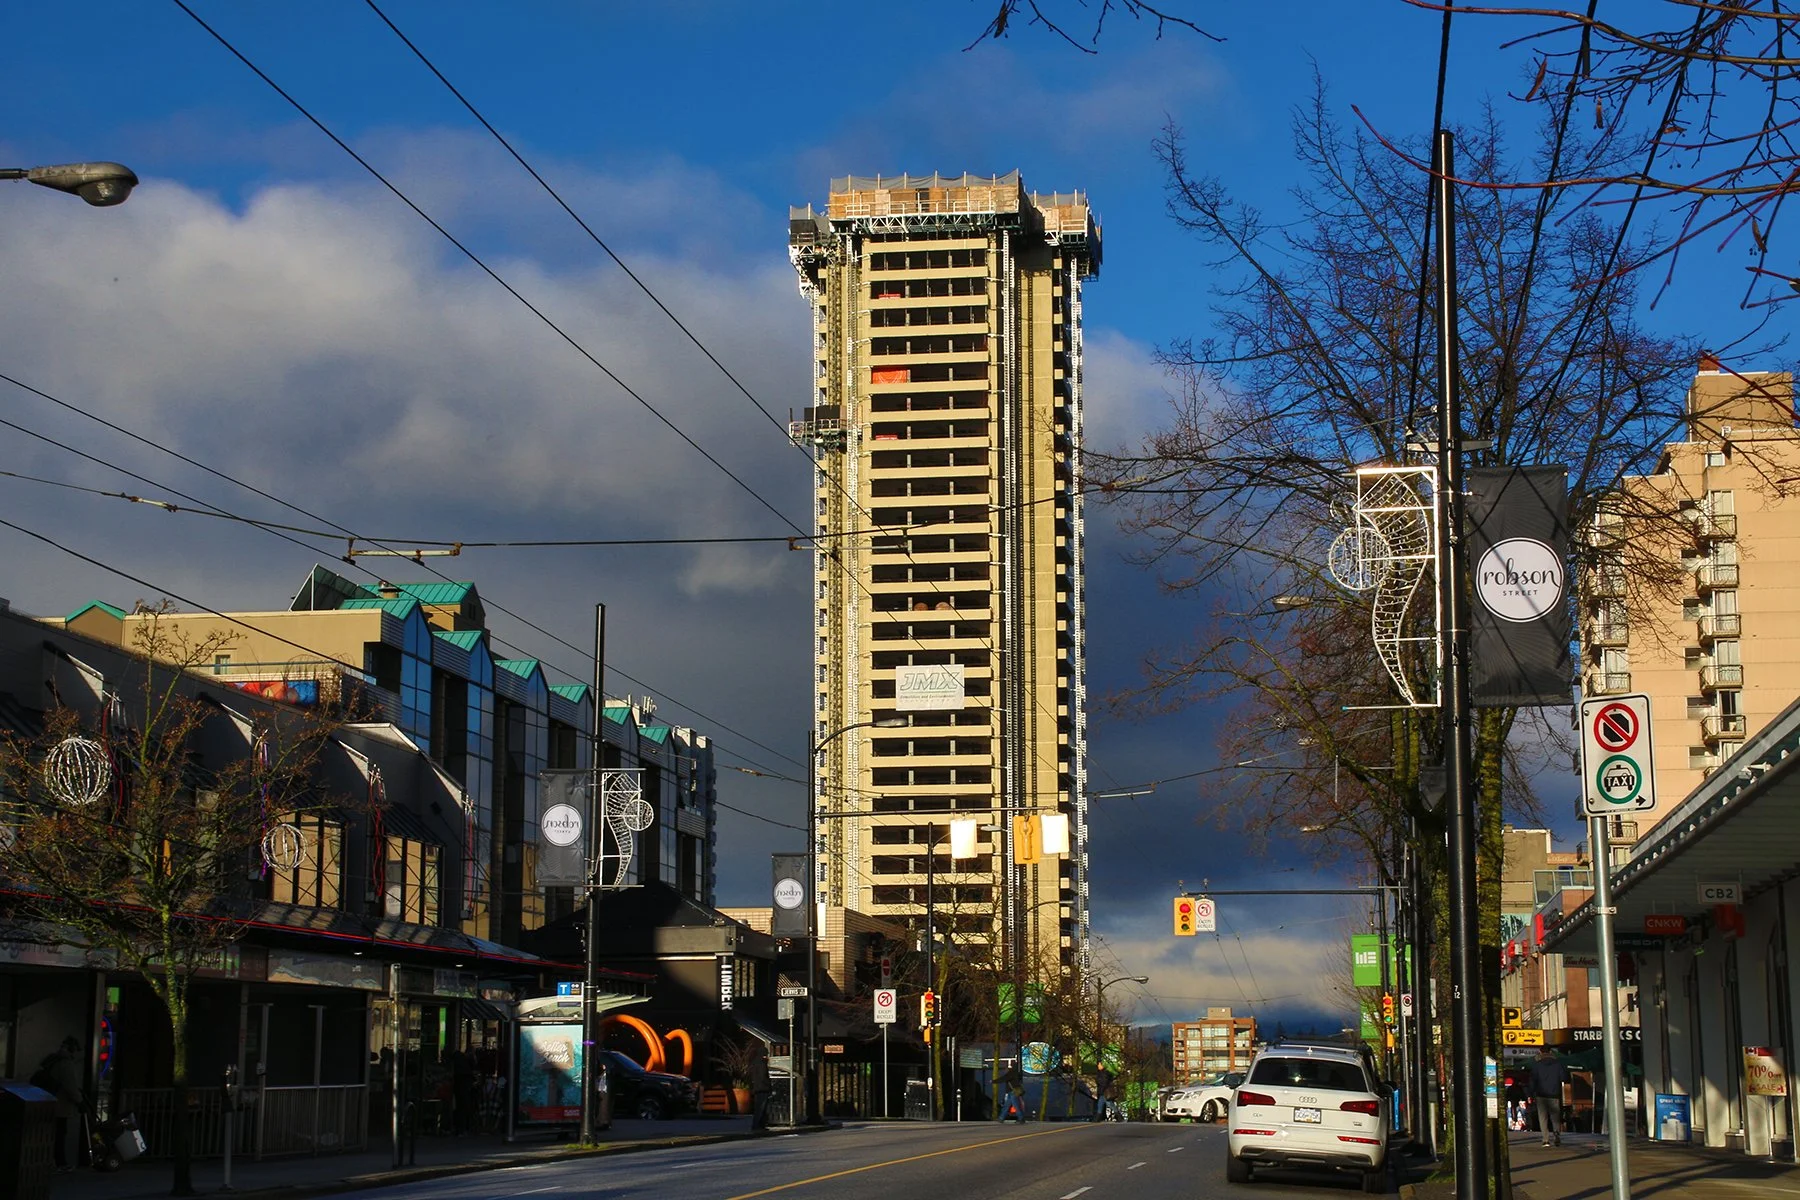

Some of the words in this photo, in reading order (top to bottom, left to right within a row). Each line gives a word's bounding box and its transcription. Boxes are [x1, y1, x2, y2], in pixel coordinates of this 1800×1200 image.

[1484, 557, 1560, 588] robson
[1502, 589, 1538, 597] STREET
[900, 671, 960, 691] JMX
[1606, 775, 1633, 788] TAXI
[1704, 888, 1734, 899] CB2
[1646, 919, 1682, 928] CNKW
[1503, 1008, 1519, 1025] P
[1574, 1030, 1633, 1041] STARBKS
[1748, 1065, 1773, 1080] 70%
